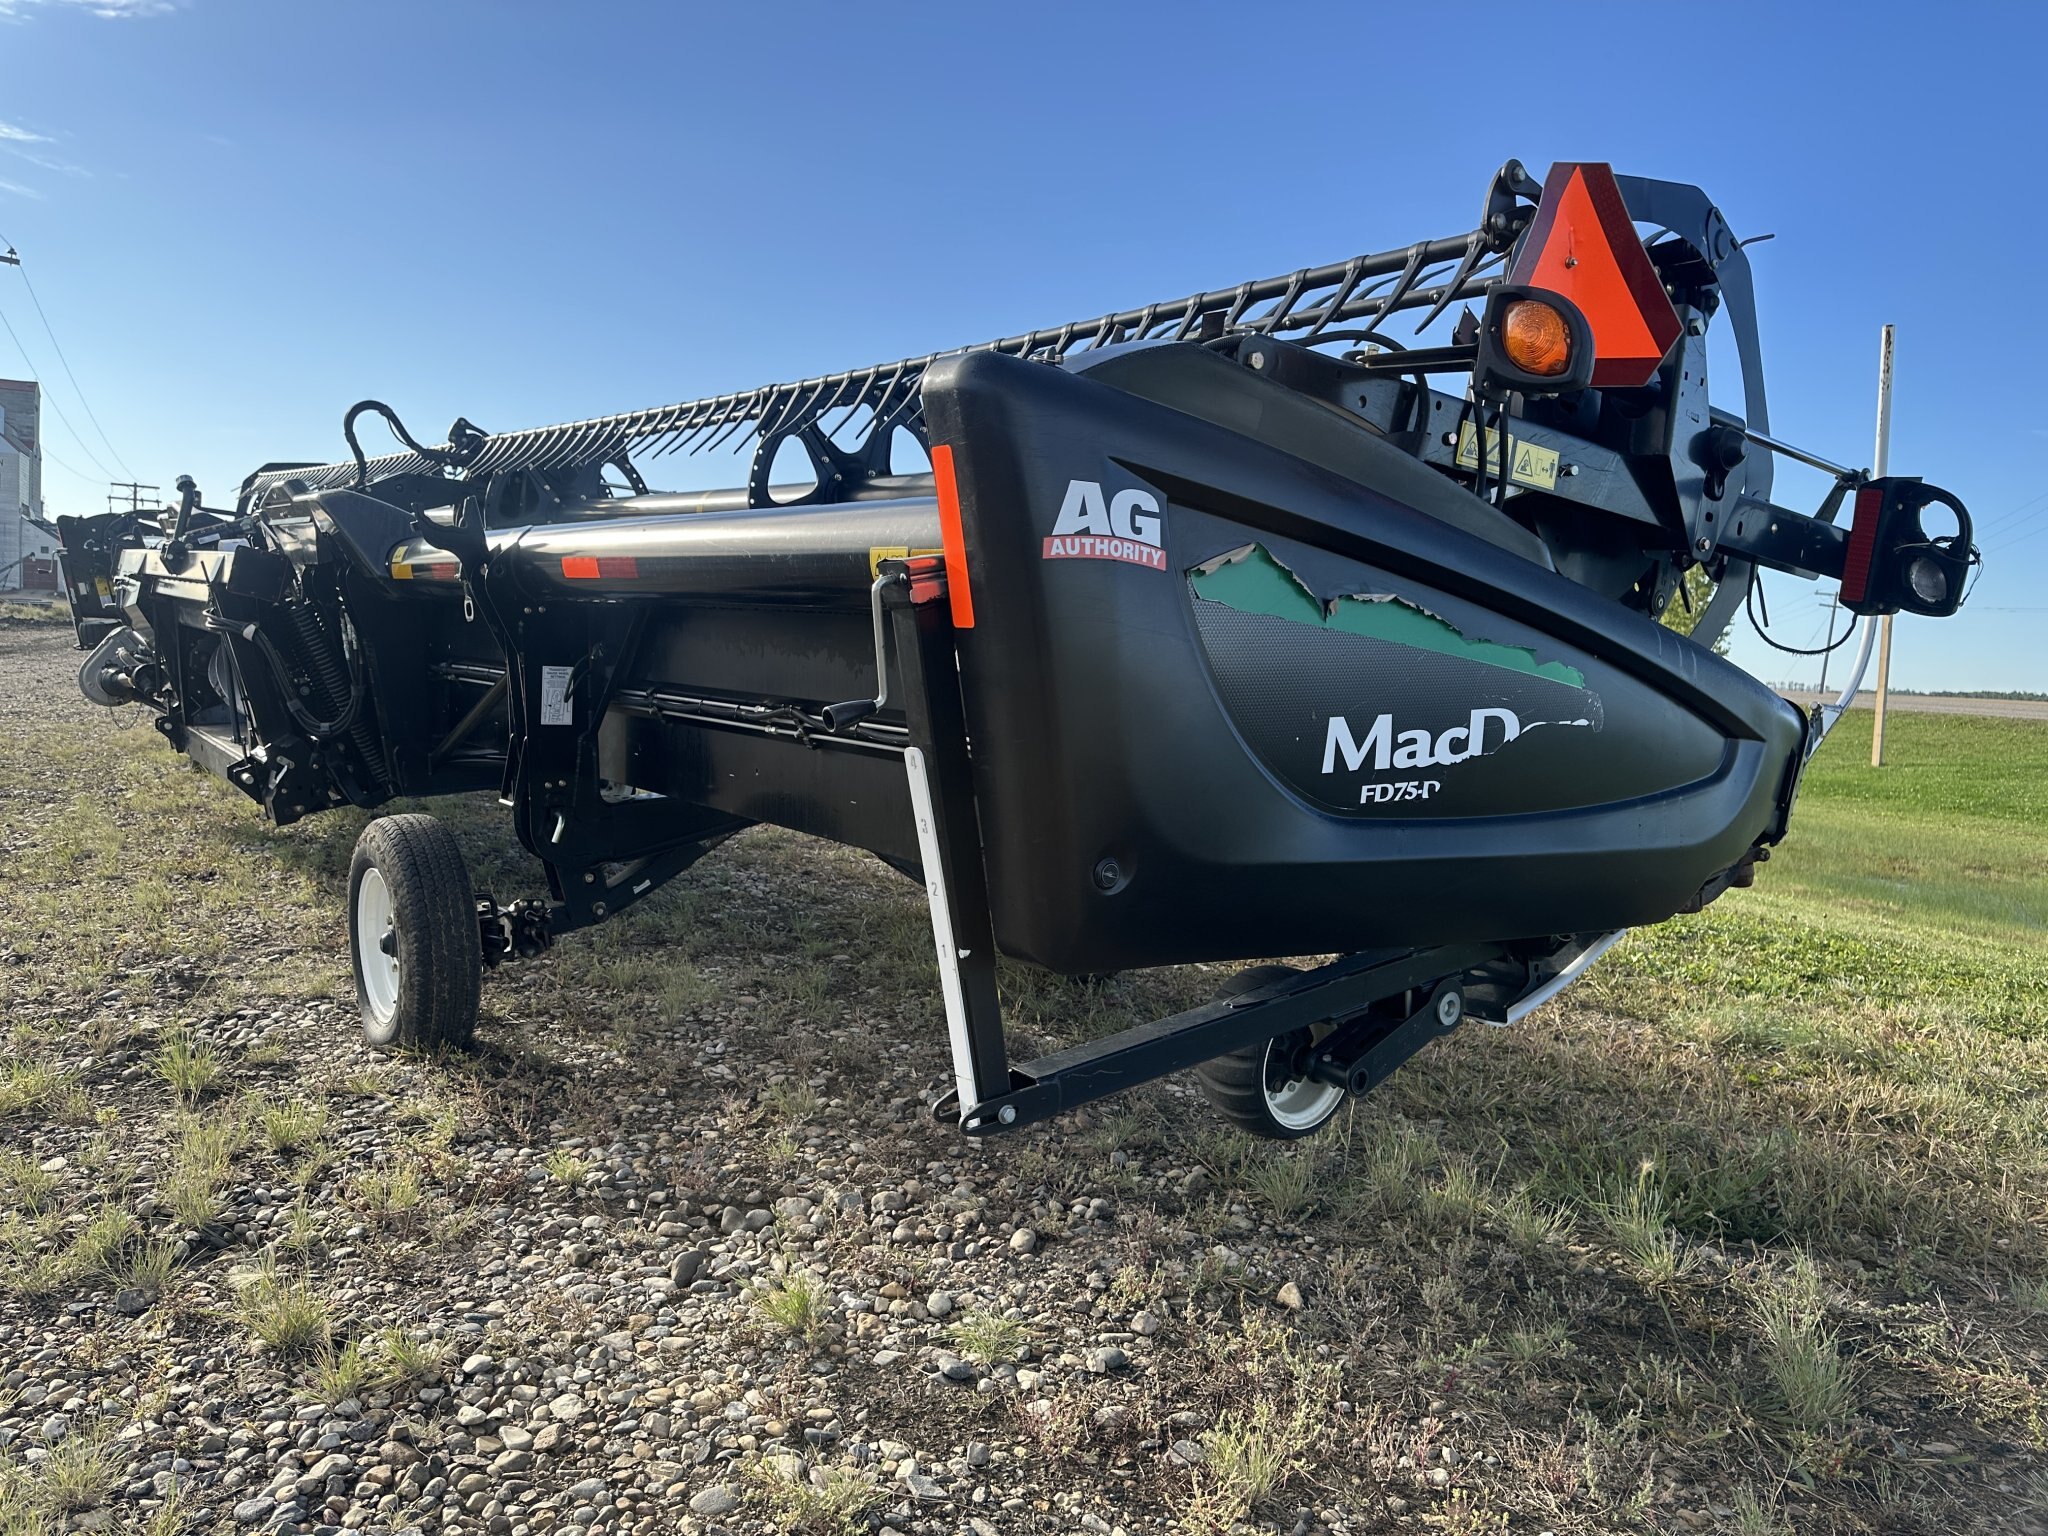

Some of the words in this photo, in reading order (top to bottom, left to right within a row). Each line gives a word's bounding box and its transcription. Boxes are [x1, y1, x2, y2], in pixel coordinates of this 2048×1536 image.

[1051, 479, 1161, 549] AG
[1050, 537, 1162, 566] AUTHORITY
[1321, 707, 1590, 774] MacD
[931, 881, 939, 897] 2
[941, 944, 947, 959] 1
